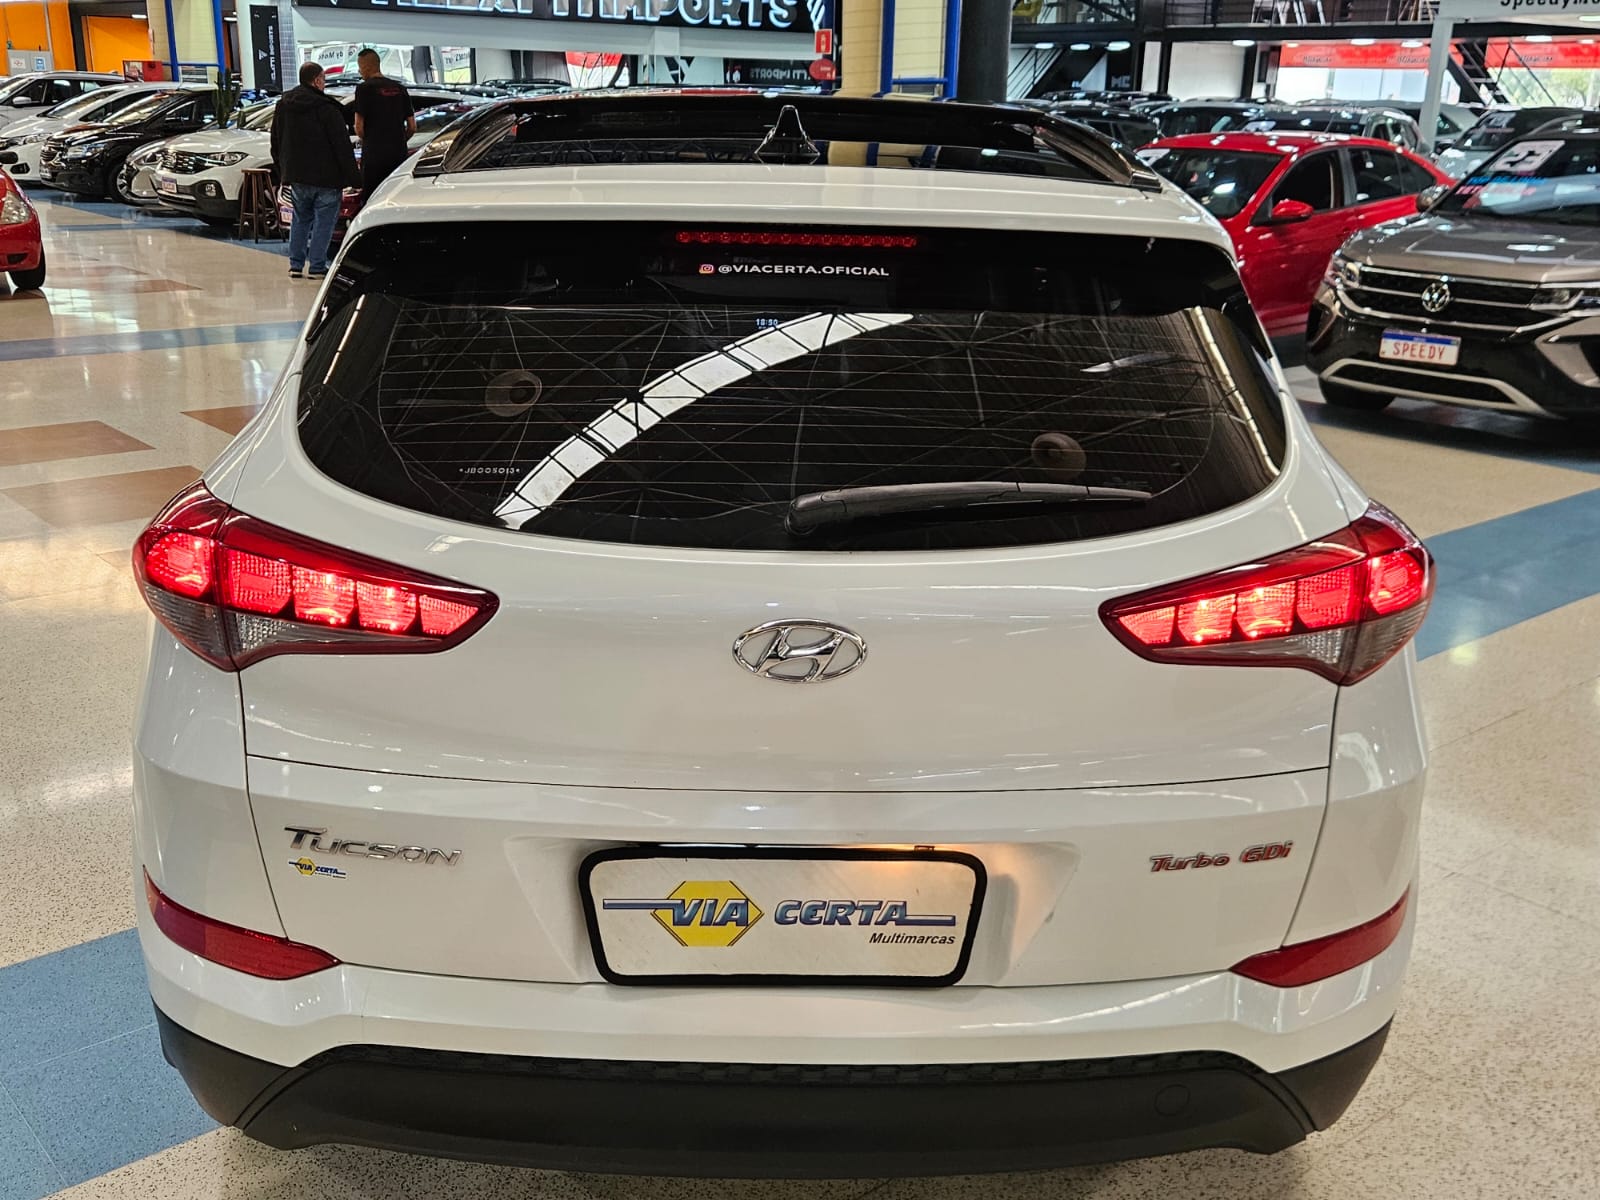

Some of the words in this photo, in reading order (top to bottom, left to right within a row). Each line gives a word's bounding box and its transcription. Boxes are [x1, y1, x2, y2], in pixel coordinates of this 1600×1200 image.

[718, 264, 889, 277] @VIACERTA.OFICIAL
[1393, 342, 1446, 360] SPEEDY
[1150, 852, 1230, 873] Turbo
[672, 898, 749, 927] VIA
[774, 900, 908, 926] CERTA
[869, 932, 956, 945] Multimarcas
